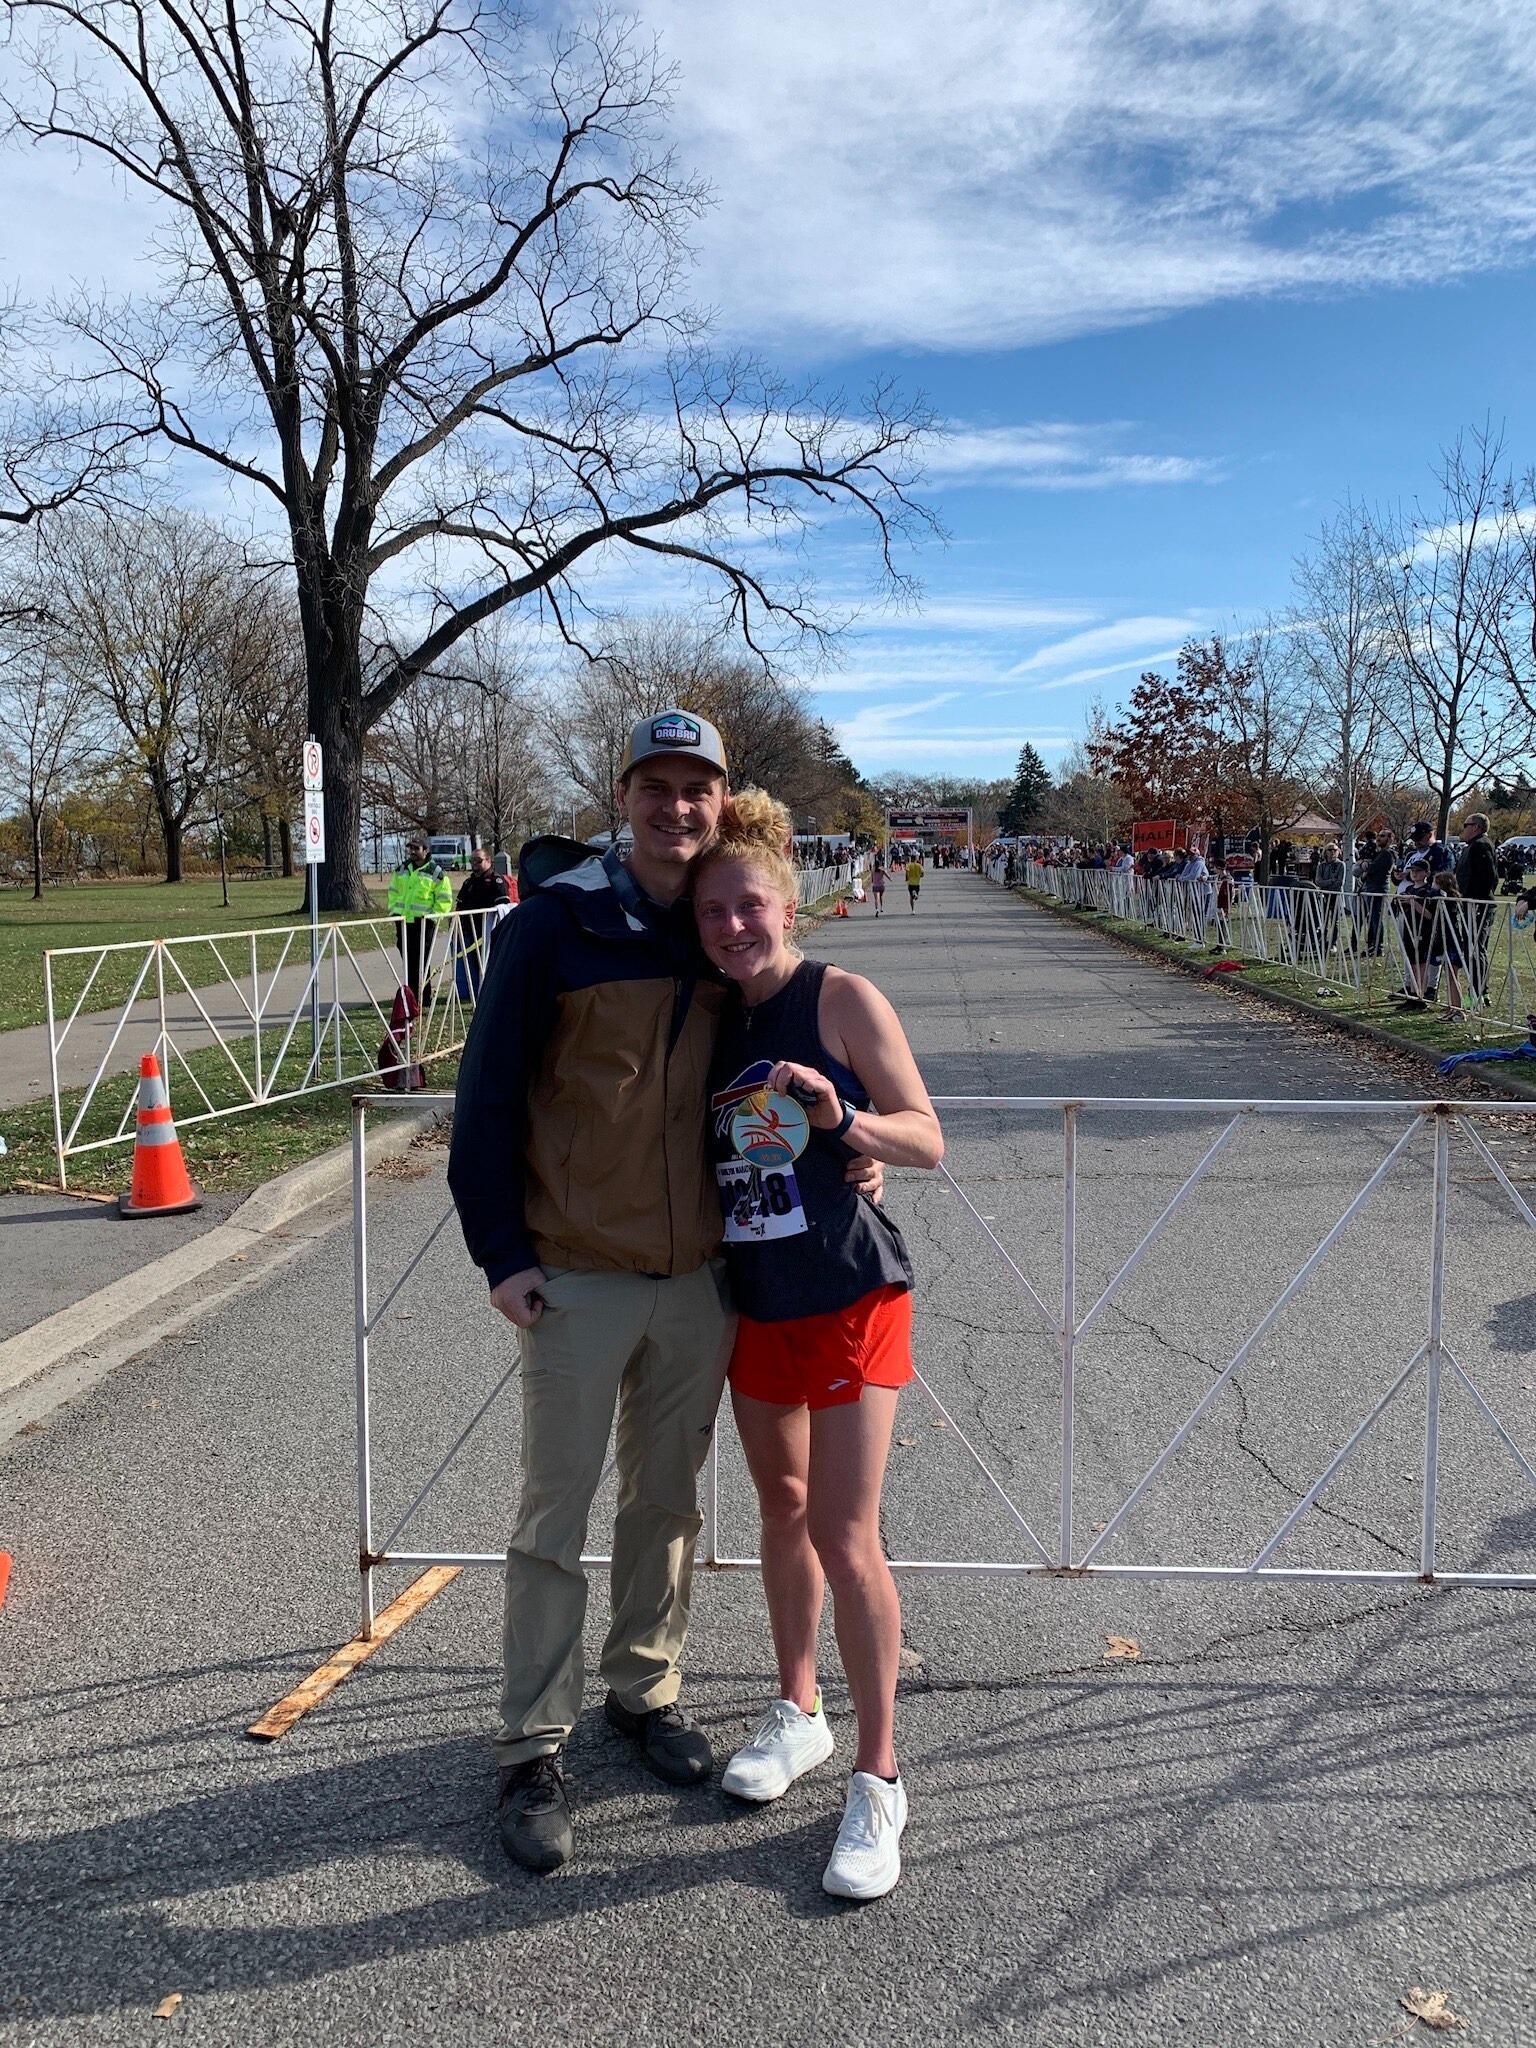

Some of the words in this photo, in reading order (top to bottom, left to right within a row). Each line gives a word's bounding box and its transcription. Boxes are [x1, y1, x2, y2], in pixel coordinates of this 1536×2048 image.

[656, 729, 675, 738] DRU
[676, 729, 697, 740] BRU
[1134, 830, 1172, 842] HALF
